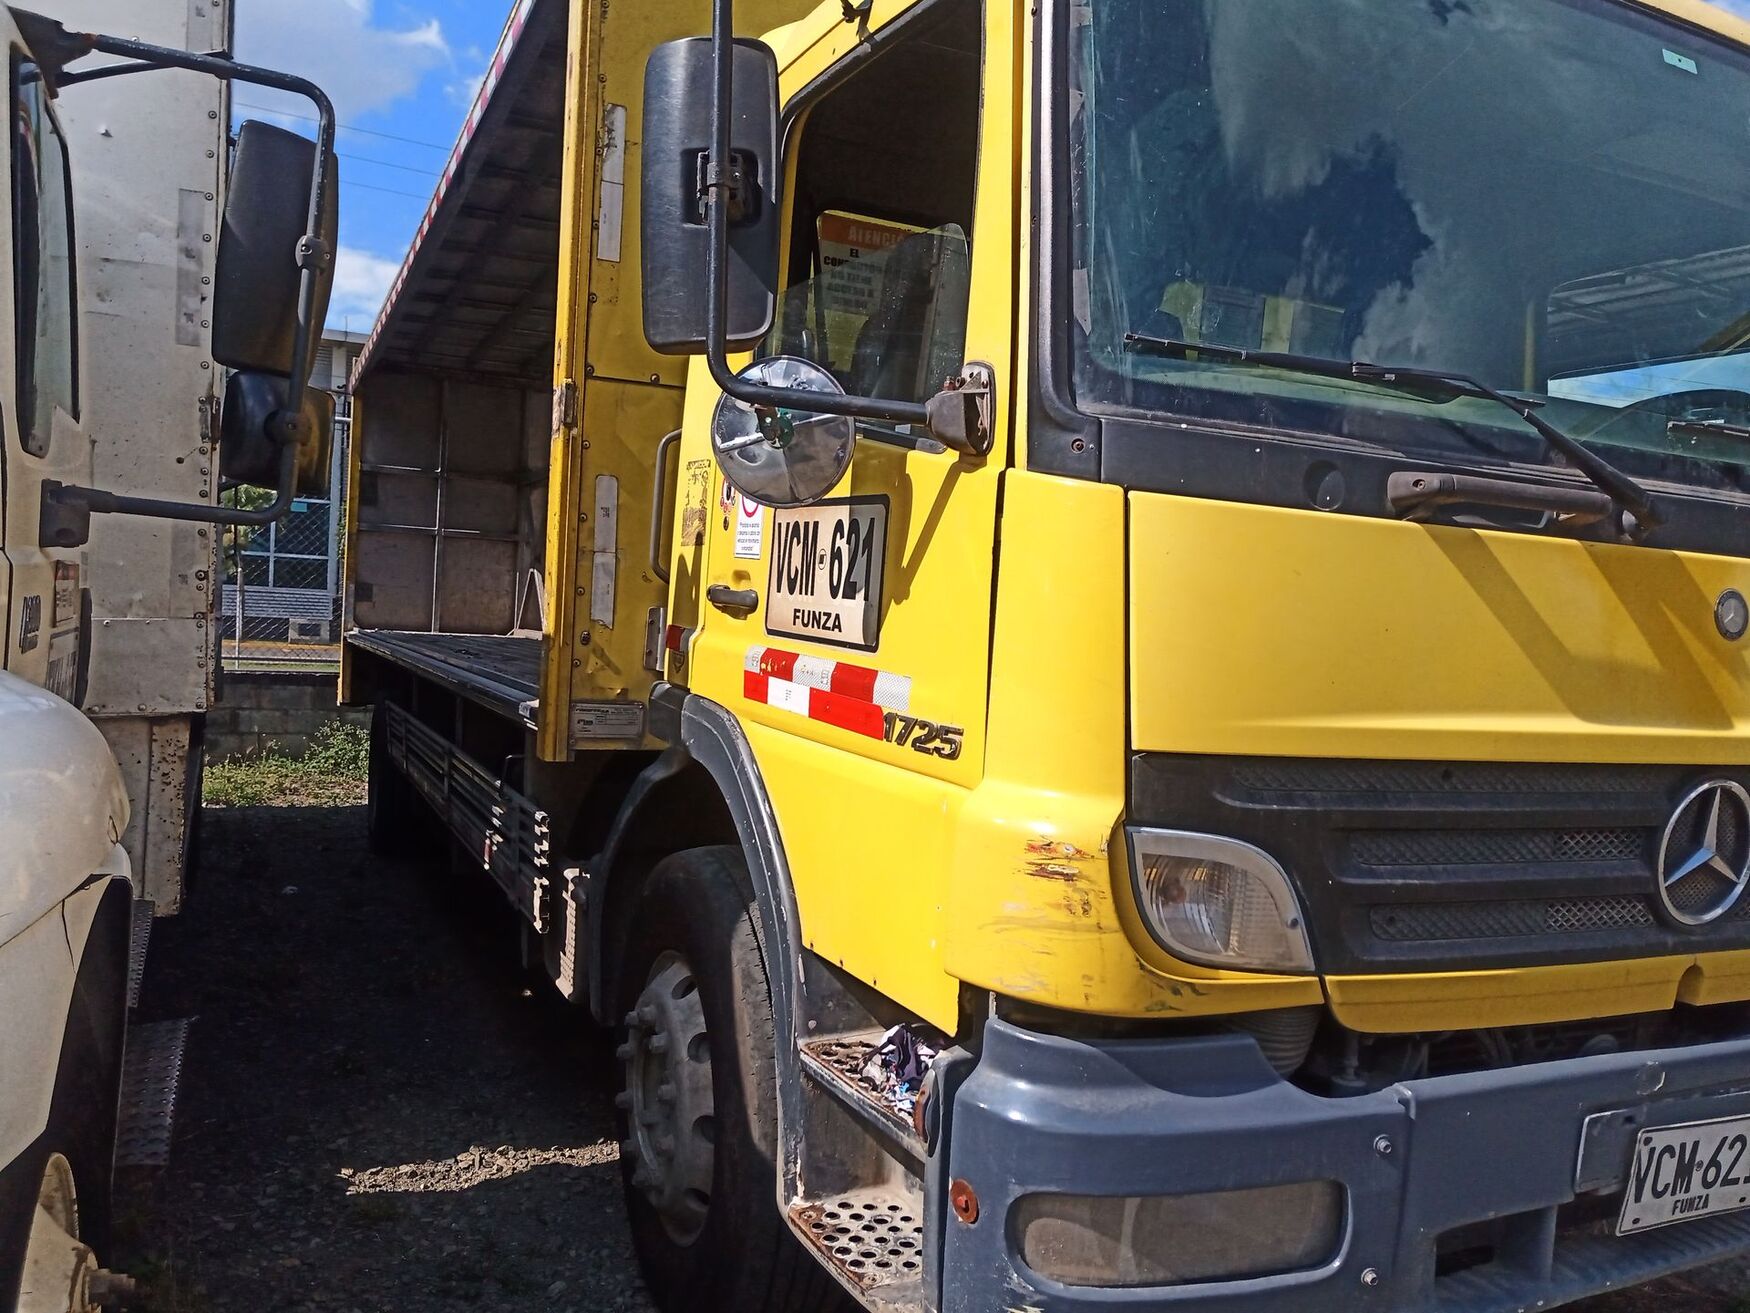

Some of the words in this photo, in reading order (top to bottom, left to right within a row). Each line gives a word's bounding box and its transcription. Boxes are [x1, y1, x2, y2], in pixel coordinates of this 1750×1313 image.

[848, 226, 906, 246] ATENCI
[849, 247, 860, 258] EL
[776, 520, 820, 597] VCM
[828, 517, 876, 602] 621
[792, 607, 843, 633] FUNZA
[883, 711, 964, 761] 1725
[1633, 1140, 1701, 1204] VCM
[1701, 1133, 1750, 1190] 62
[1671, 1193, 1710, 1216] FUNZA
